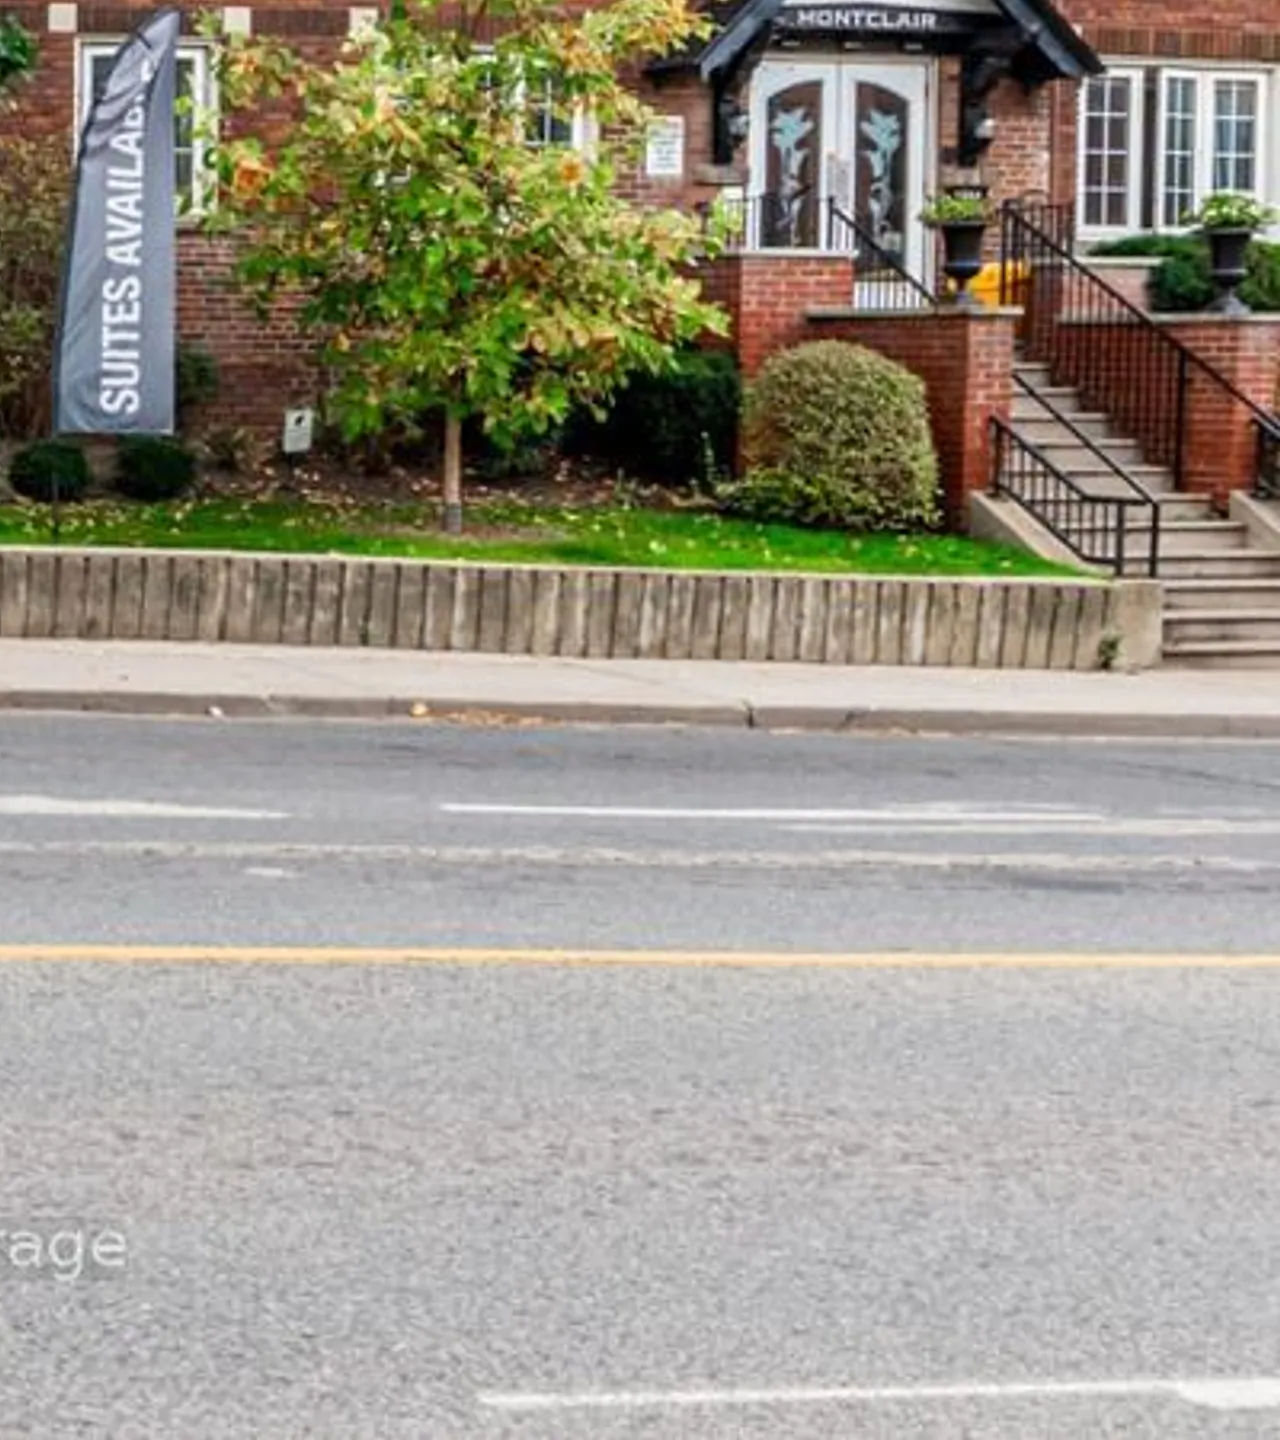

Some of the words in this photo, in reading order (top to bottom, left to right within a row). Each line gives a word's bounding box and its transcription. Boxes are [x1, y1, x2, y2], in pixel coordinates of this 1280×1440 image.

[796, 9, 937, 30] MONTCLAIR
[105, 59, 154, 266] AVAILAB
[99, 275, 142, 415] SUITES
